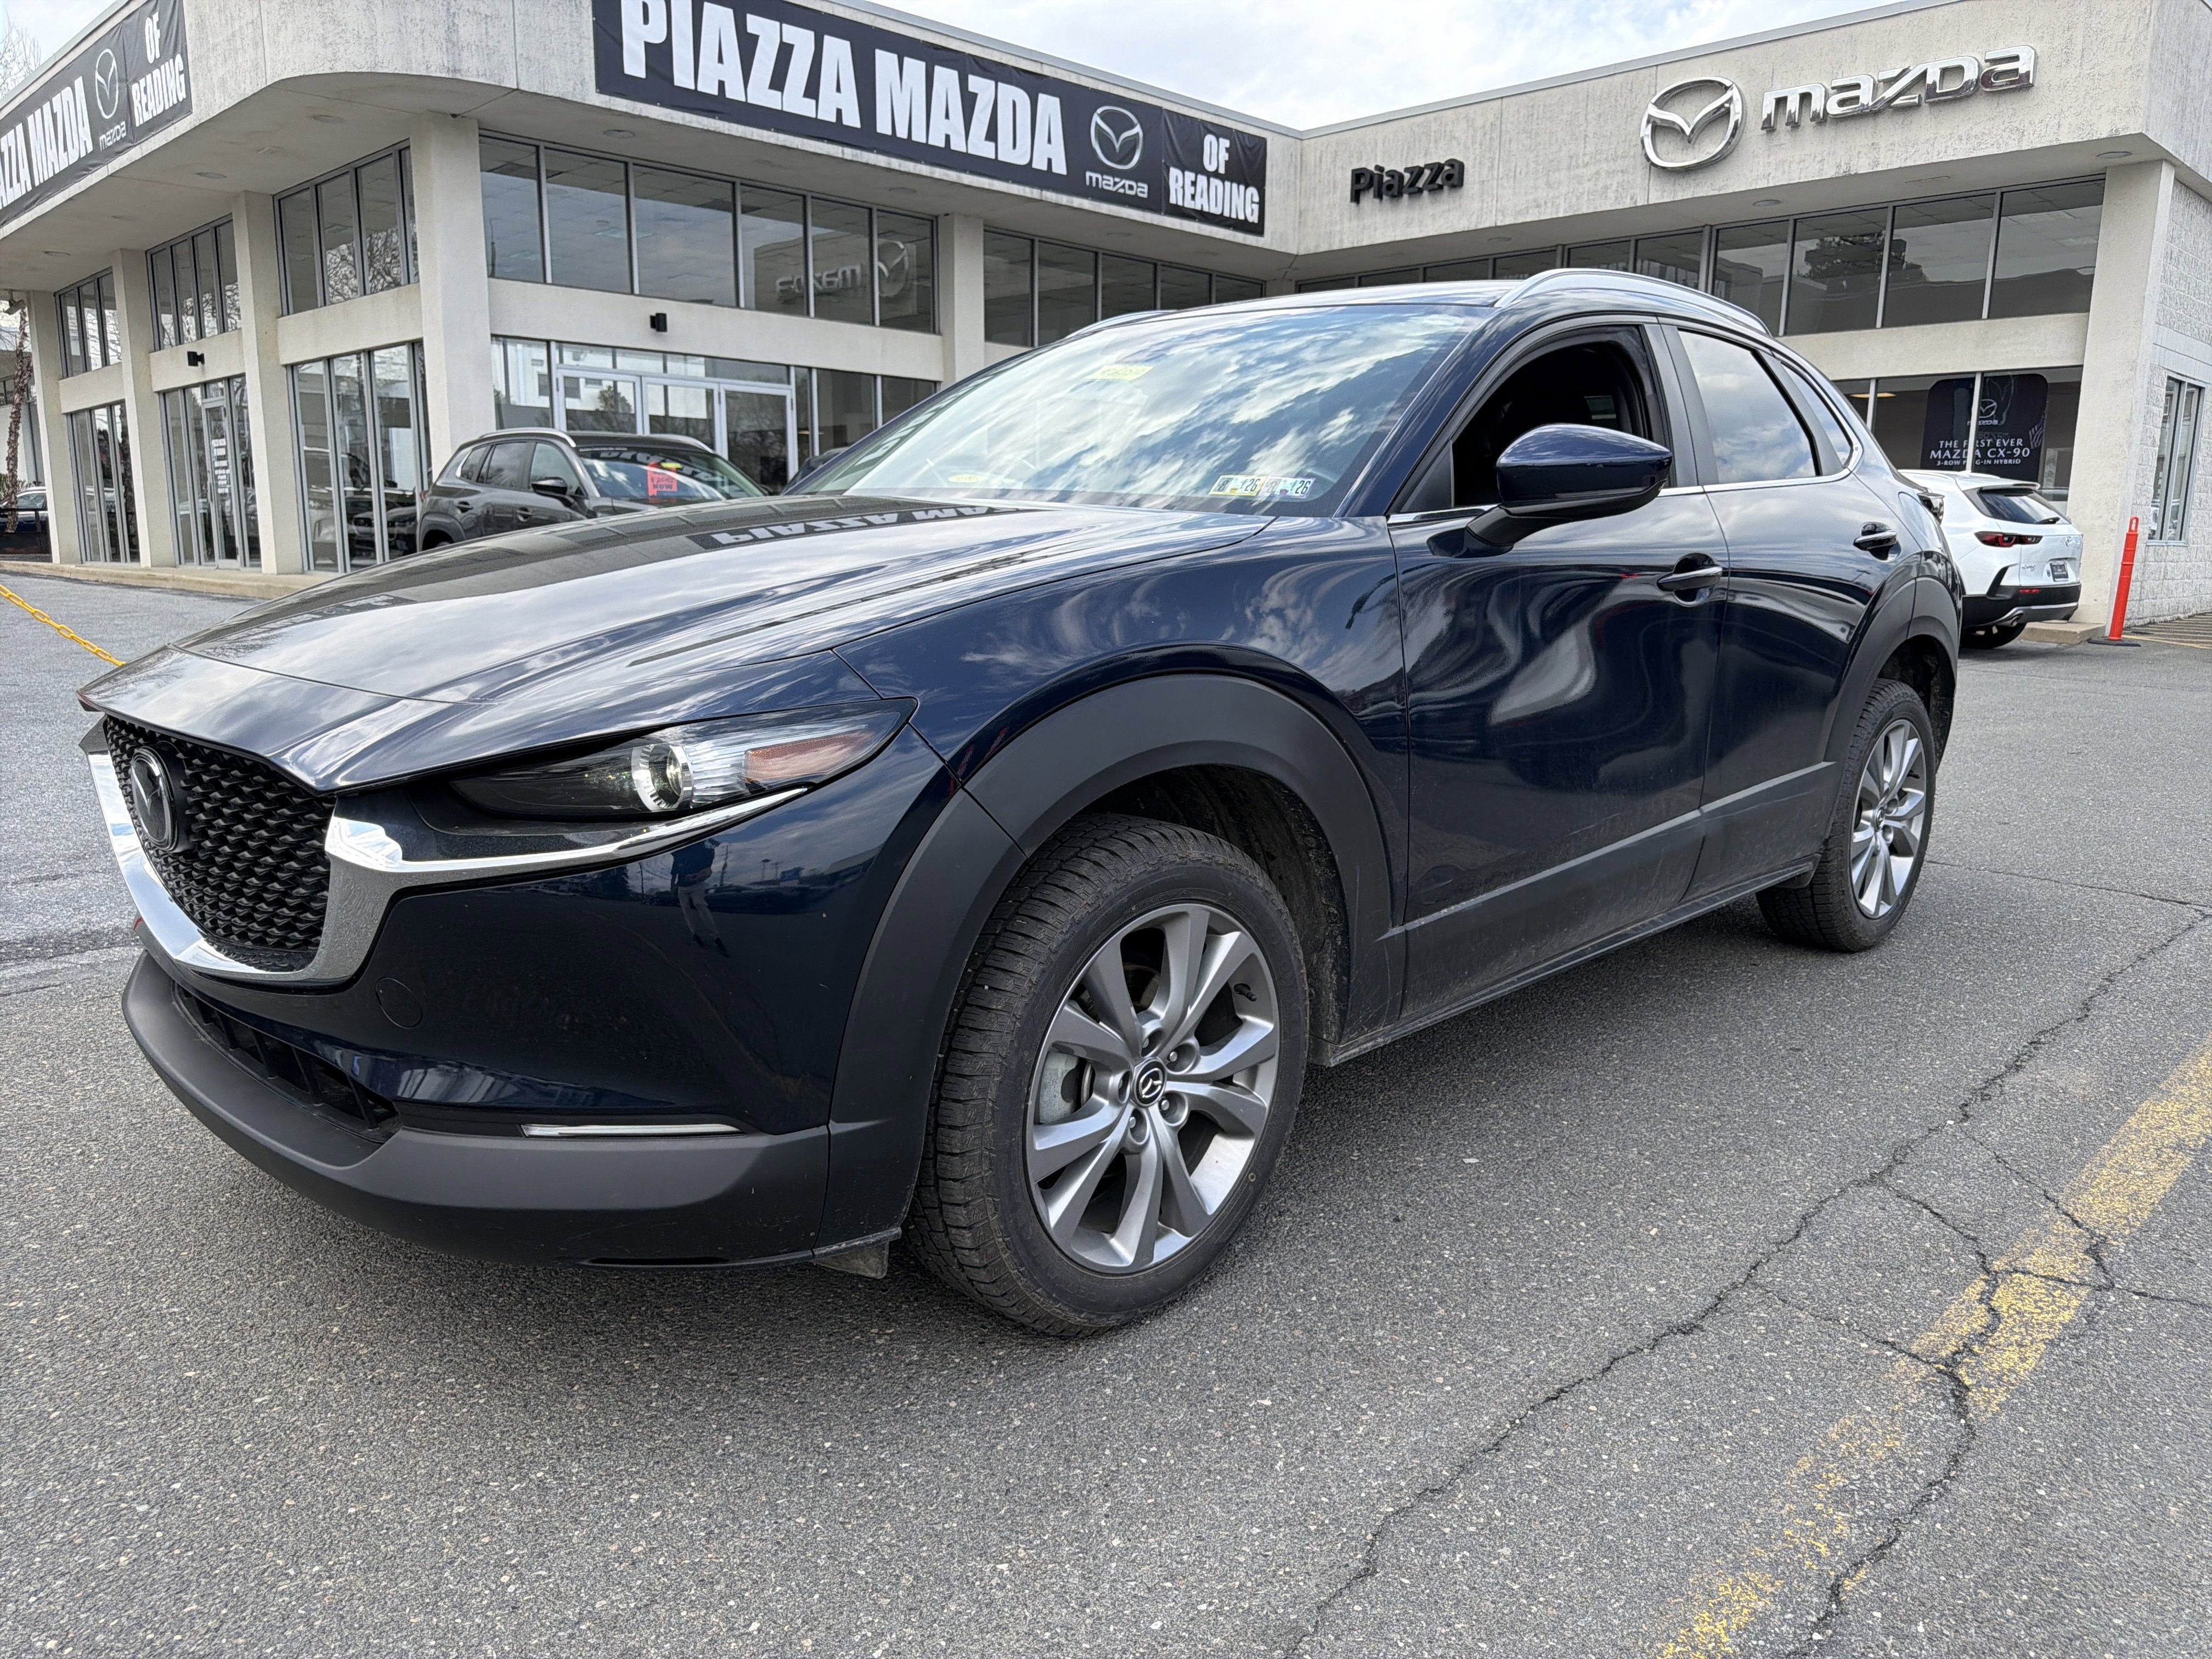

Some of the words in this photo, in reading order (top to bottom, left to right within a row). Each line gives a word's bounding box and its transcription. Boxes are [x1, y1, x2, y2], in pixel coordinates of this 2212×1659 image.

[145, 12, 160, 64] OF
[132, 53, 187, 127] READING
[621, 0, 861, 129] PIAZZA
[876, 49, 1068, 176] MAZDA
[1761, 45, 2039, 131] mazda
[27, 76, 93, 187] MAZDA
[99, 121, 127, 151] mazda
[1203, 134, 1231, 174] OF
[1085, 170, 1149, 199] mazda
[1169, 167, 1260, 224] READING
[1350, 158, 1465, 205] Piazza
[1939, 440, 1959, 448] THE
[1963, 439, 1993, 448] FRST
[1996, 438, 2023, 447] EVER
[1987, 447, 2030, 458] CX-90
[1244, 478, 1261, 492] 26
[1294, 480, 1311, 494] 26
